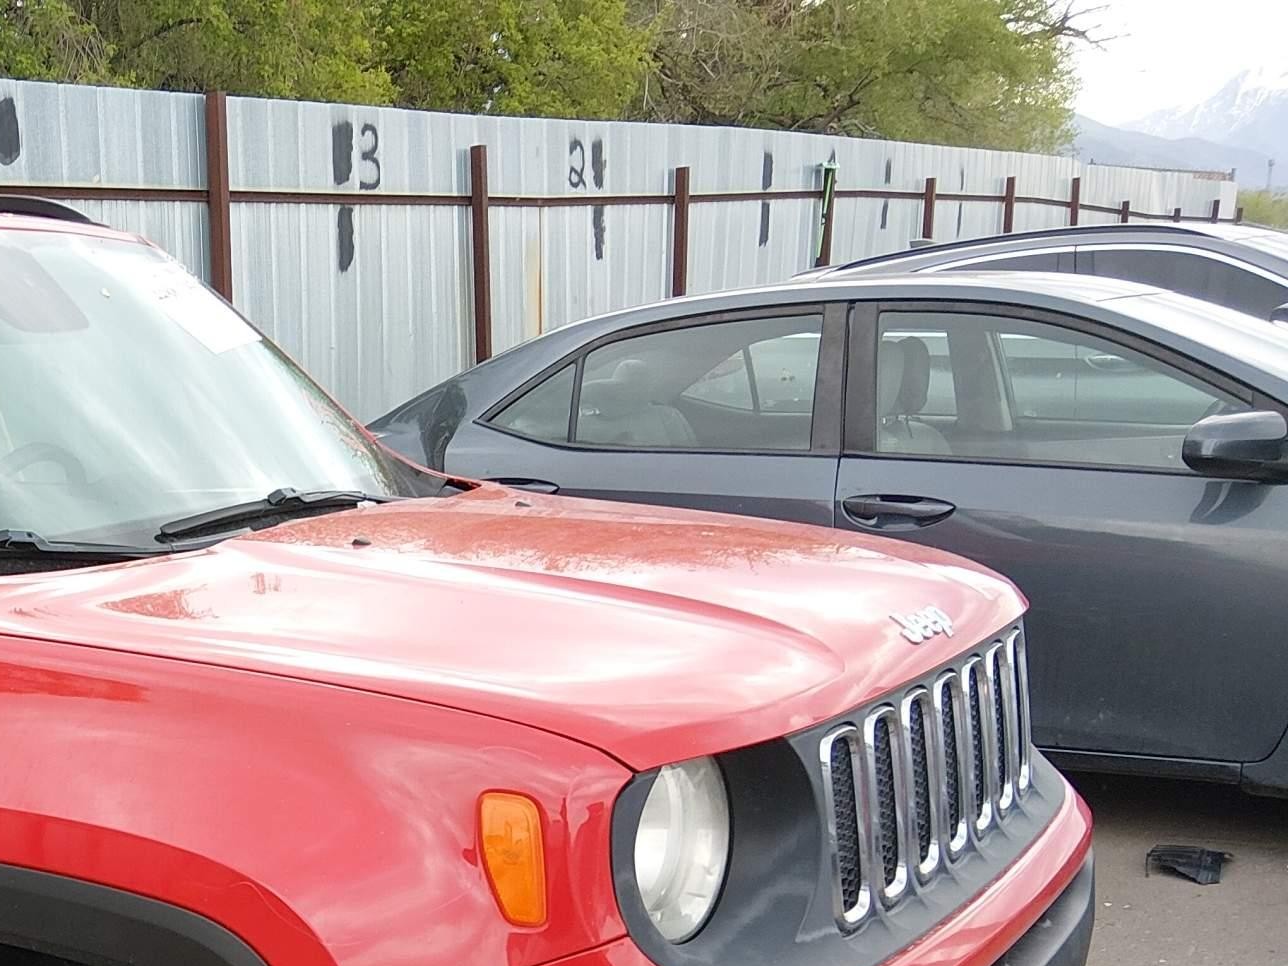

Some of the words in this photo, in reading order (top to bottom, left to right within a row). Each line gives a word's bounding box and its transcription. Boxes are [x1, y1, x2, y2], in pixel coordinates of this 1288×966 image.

[360, 123, 381, 190] 3
[568, 138, 588, 189] 2
[889, 605, 954, 645] Jeep
